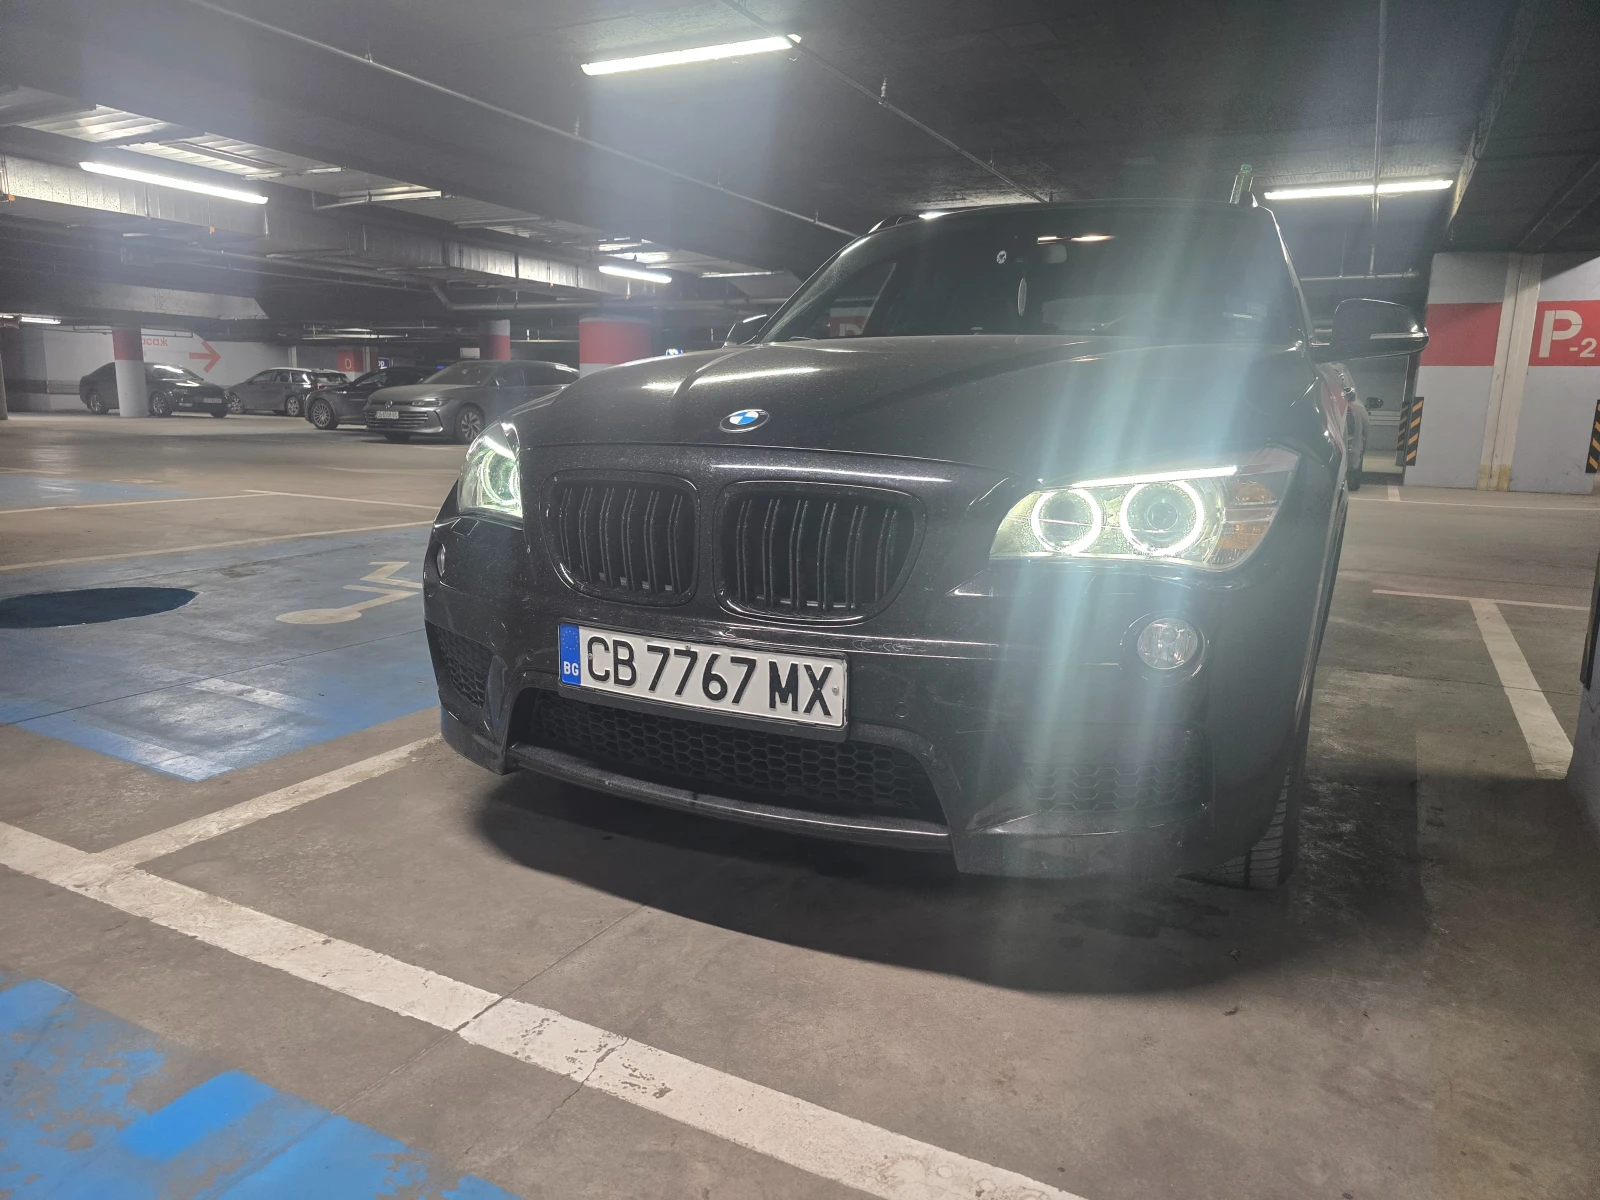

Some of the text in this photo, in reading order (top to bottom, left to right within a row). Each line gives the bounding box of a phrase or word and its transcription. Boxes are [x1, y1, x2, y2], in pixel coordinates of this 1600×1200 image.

[563, 661, 579, 676] BG
[587, 635, 833, 717] CB 7767 MX
